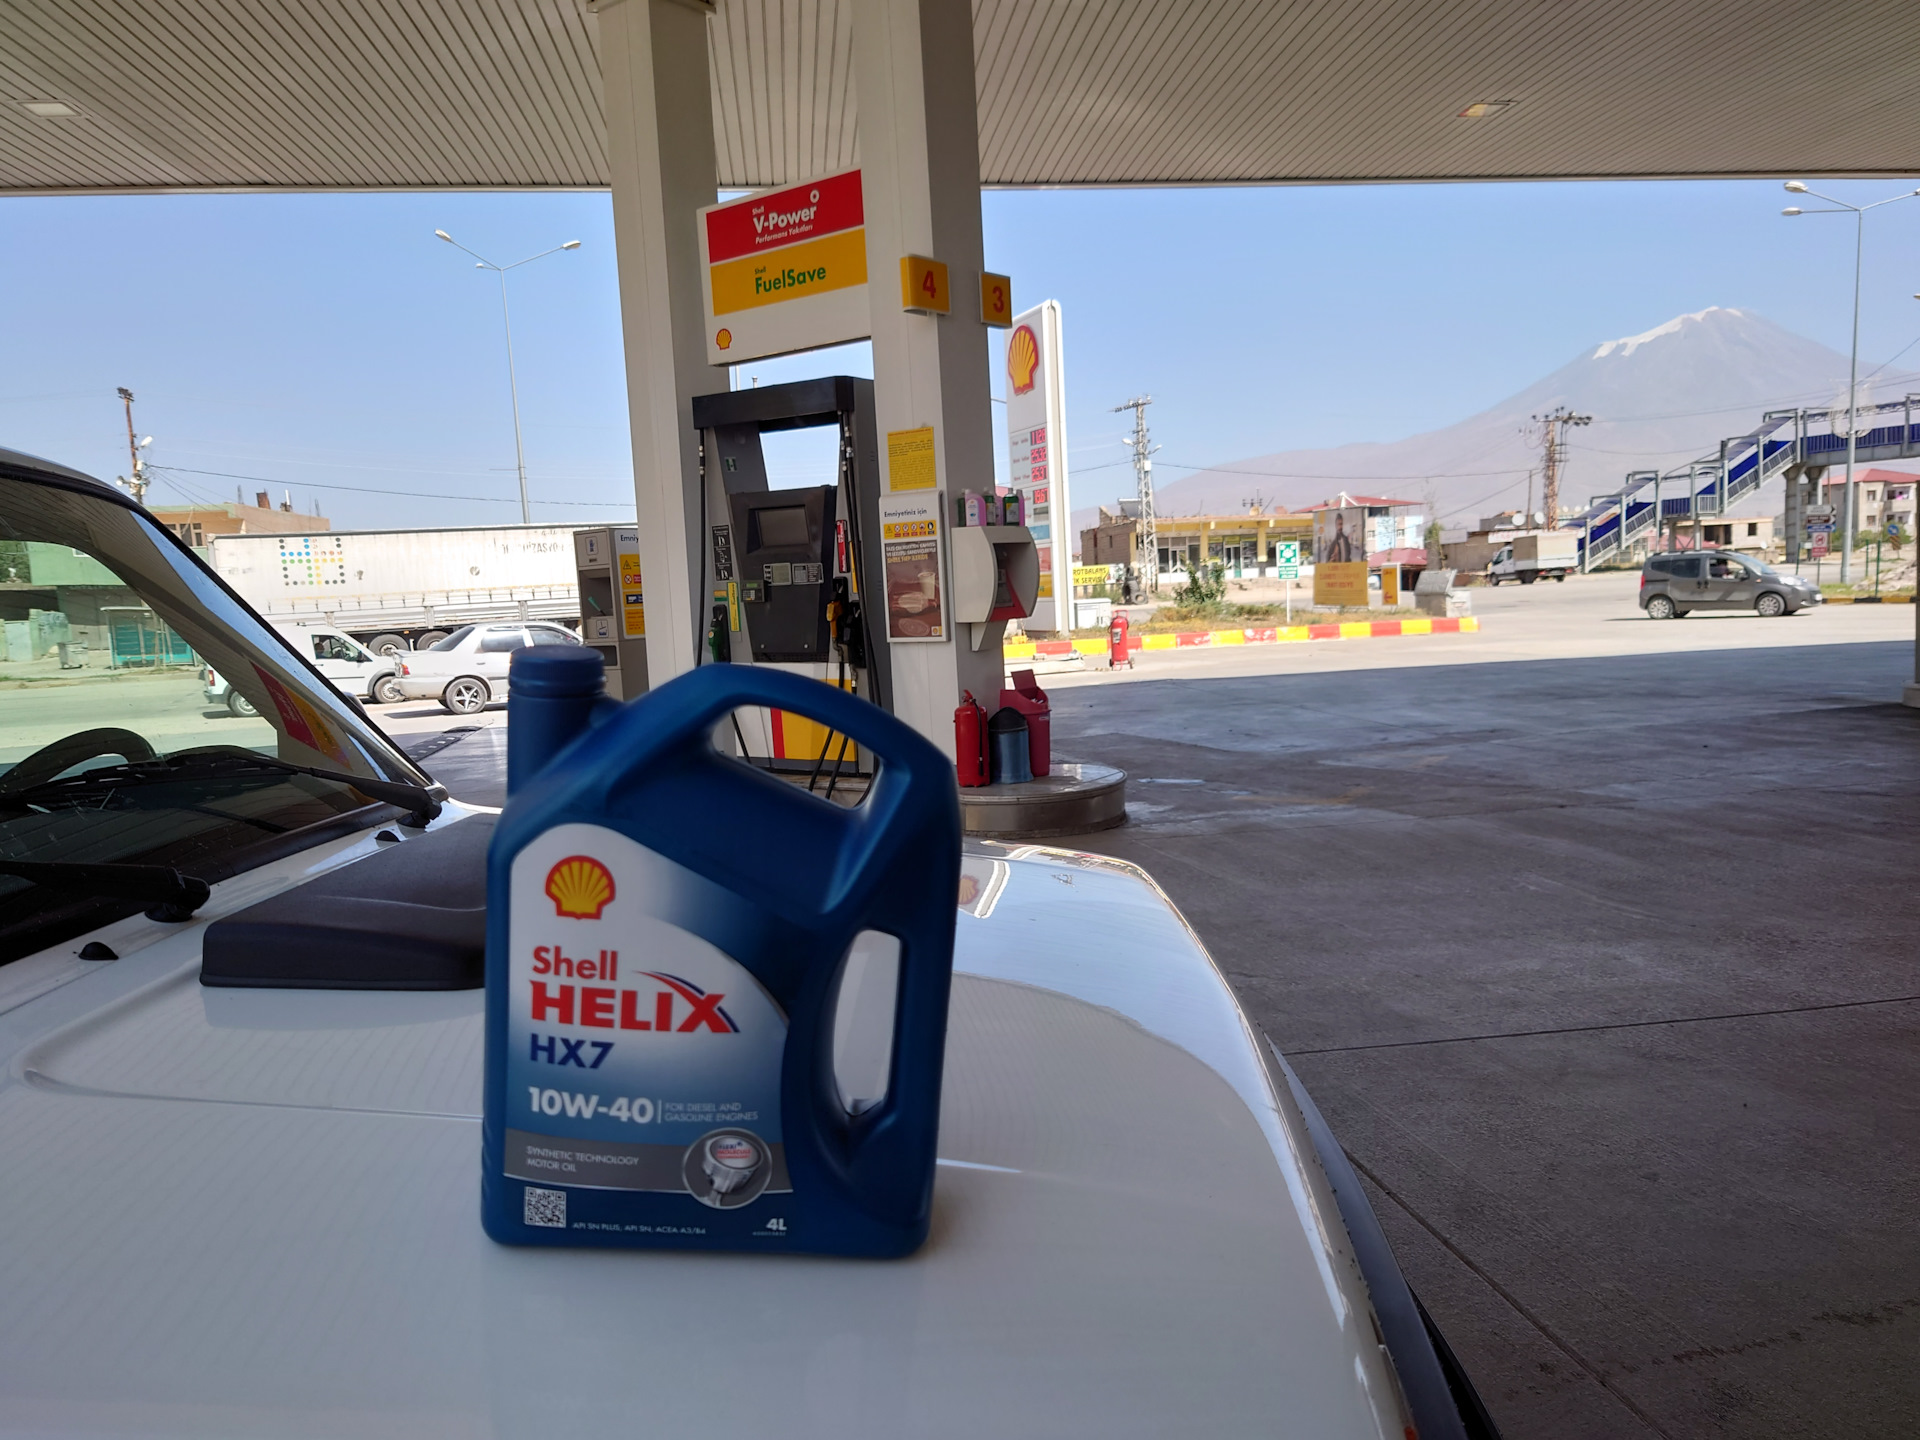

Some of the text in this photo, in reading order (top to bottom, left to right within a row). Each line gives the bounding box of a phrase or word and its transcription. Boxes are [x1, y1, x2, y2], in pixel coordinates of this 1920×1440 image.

[753, 205, 817, 234] V-Power
[755, 230, 788, 245] Performans
[755, 266, 827, 295] FuelSave
[922, 270, 937, 299] 4
[992, 286, 1005, 314] 3
[532, 945, 618, 981] Shell
[529, 972, 740, 1034] HELIX
[530, 1032, 615, 1069] HX7
[528, 1086, 655, 1124] 10W-40
[665, 1102, 742, 1112] FOR DIESEL AND
[665, 1111, 759, 1122] GASOLINE ENGINES
[526, 1145, 639, 1165] SYNTHETIC TECHNOLOGY
[526, 1158, 577, 1172] MOTOR OIL
[766, 1217, 787, 1231] 4L
